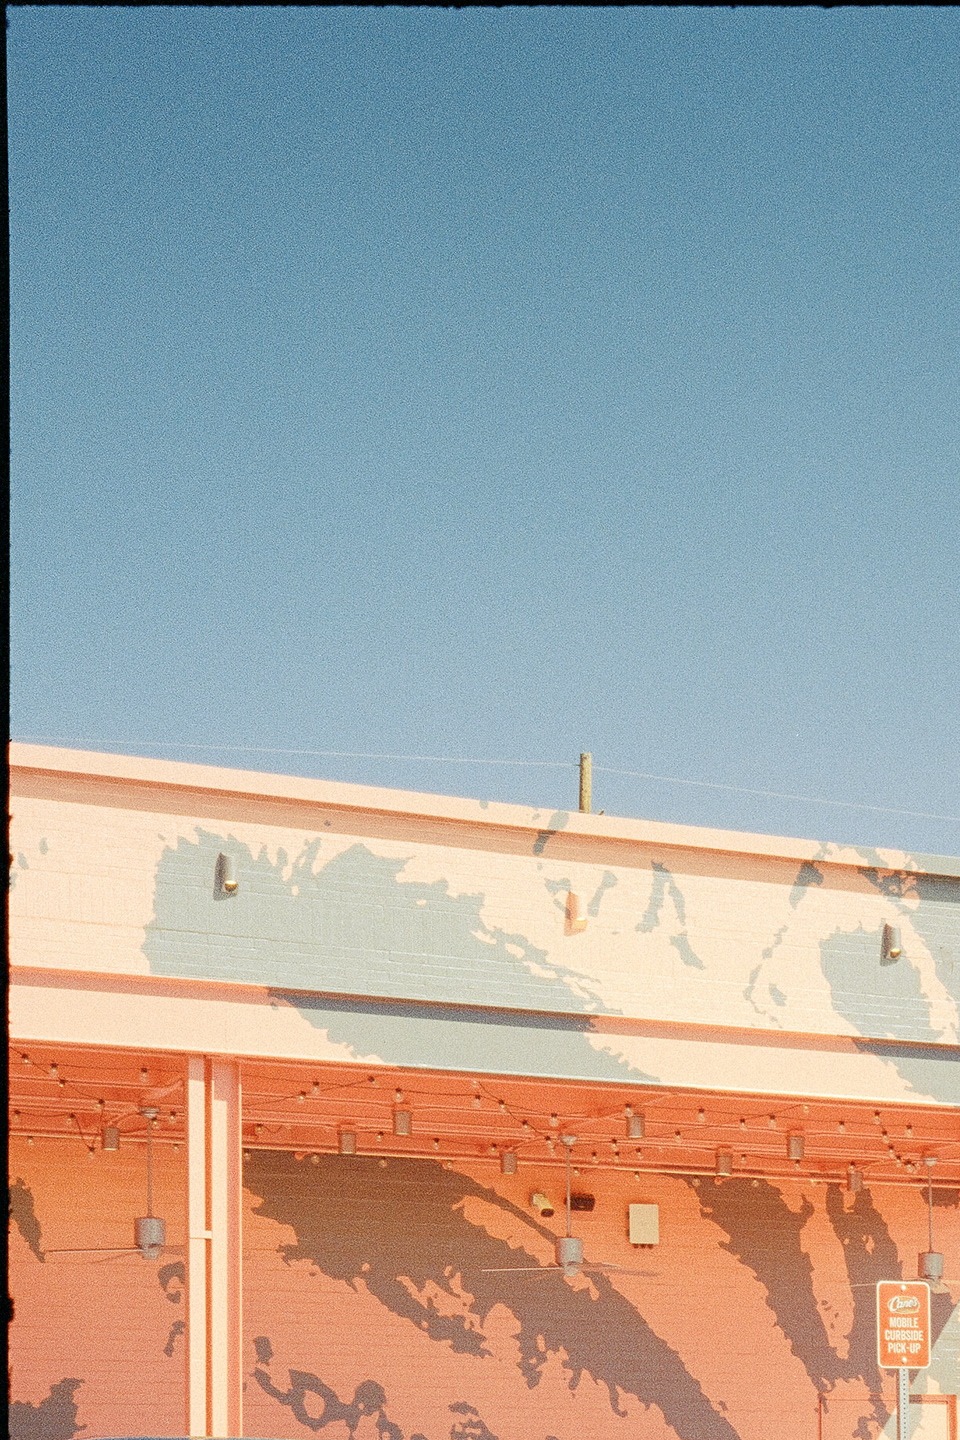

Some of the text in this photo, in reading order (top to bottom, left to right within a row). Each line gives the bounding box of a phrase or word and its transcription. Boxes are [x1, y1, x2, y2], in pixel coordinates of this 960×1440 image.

[889, 1296, 918, 1313] Cane's
[889, 1317, 919, 1328] MOBILE
[884, 1329, 924, 1341] CURBSIDE
[888, 1342, 921, 1354] PICK-UP
